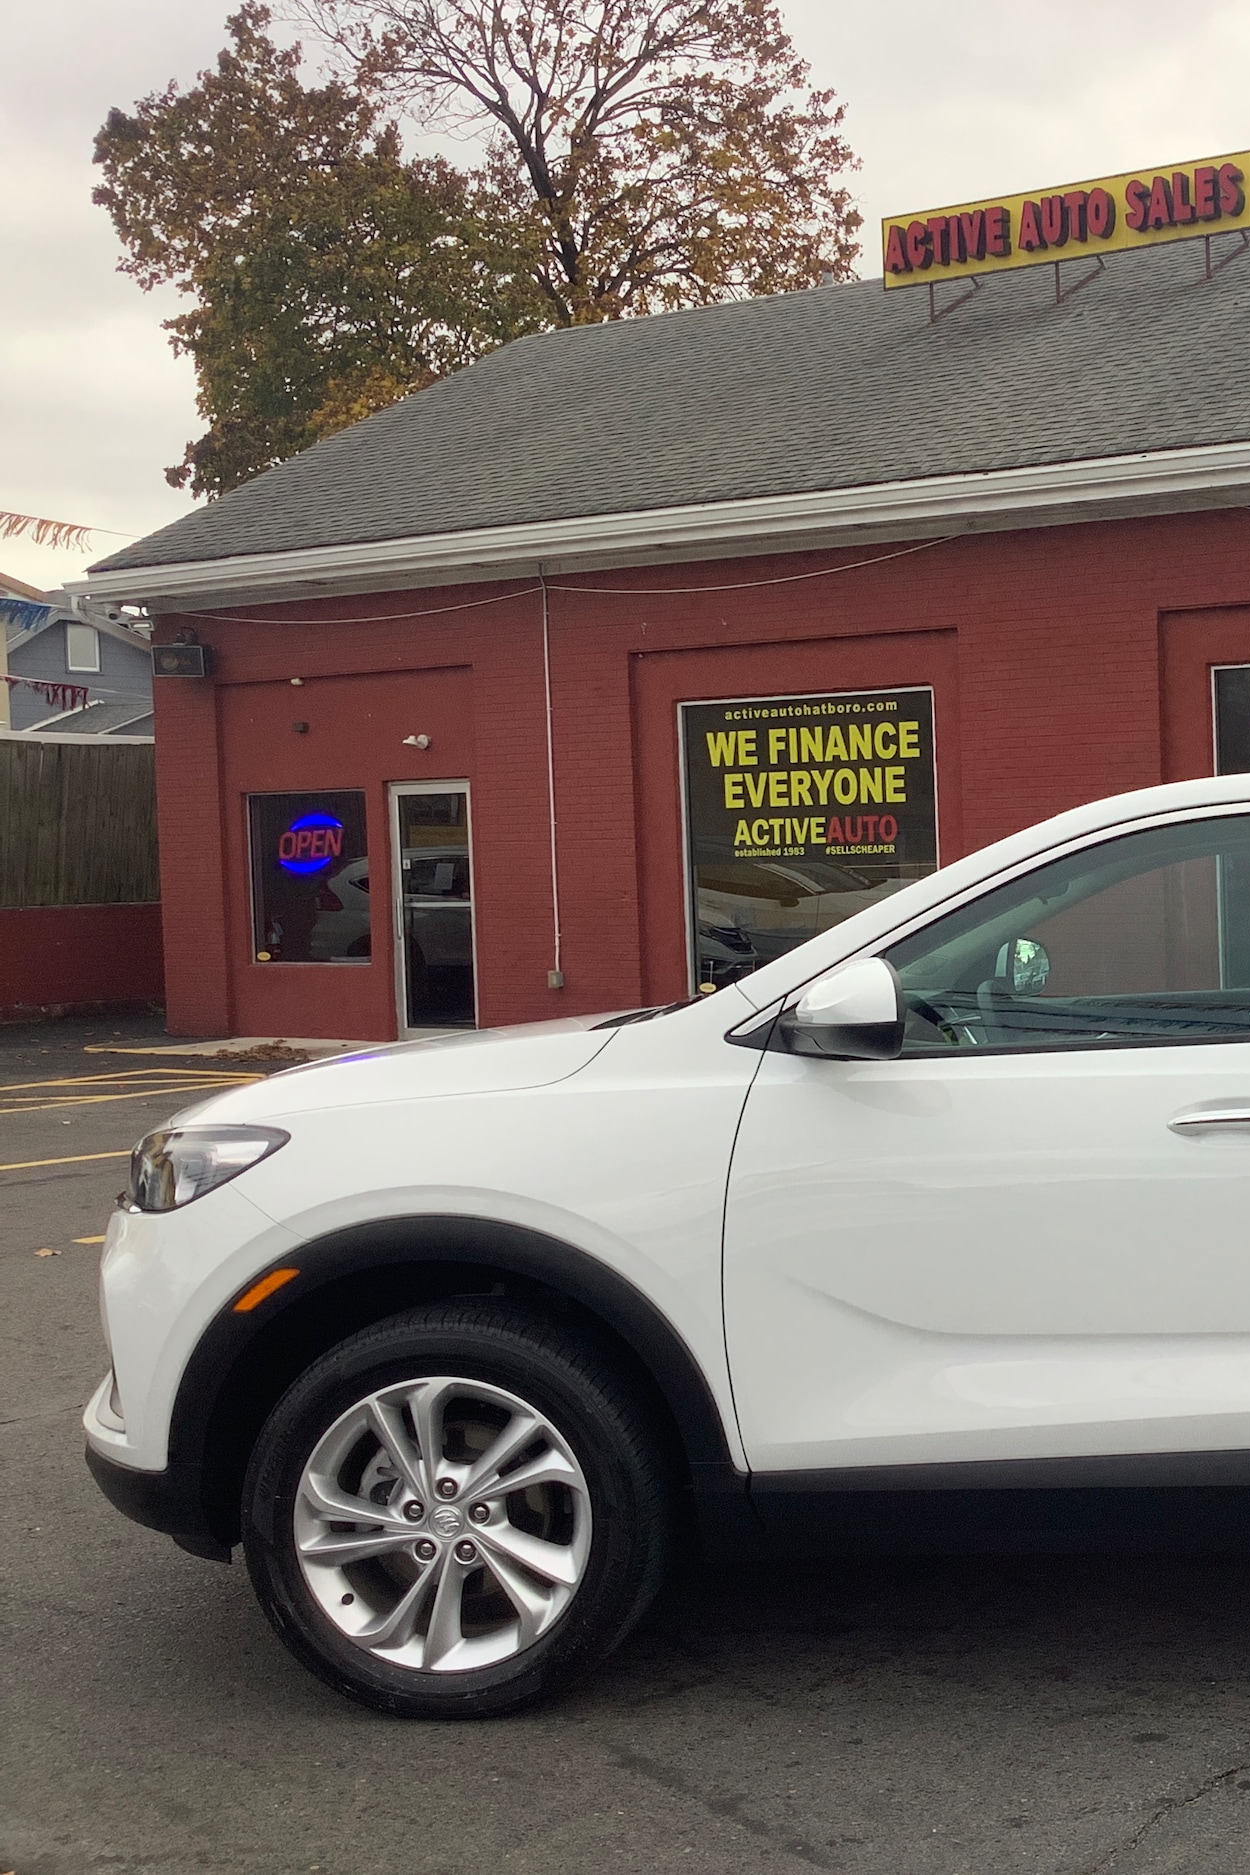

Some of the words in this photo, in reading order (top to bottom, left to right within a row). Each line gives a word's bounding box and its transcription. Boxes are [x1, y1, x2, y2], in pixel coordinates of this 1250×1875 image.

[885, 206, 1010, 274] ACTIVE
[1018, 188, 1115, 250] AUTO
[1125, 163, 1245, 232] SALES
[724, 701, 898, 721] activeautohatboro.com
[706, 730, 758, 767] WE
[768, 721, 920, 764] FINANCE
[724, 766, 906, 808] EVERYONE
[279, 829, 343, 859] OPEN
[734, 847, 781, 857] established
[783, 847, 805, 856] 1983
[825, 845, 895, 855] #SELLSCHEAPER
